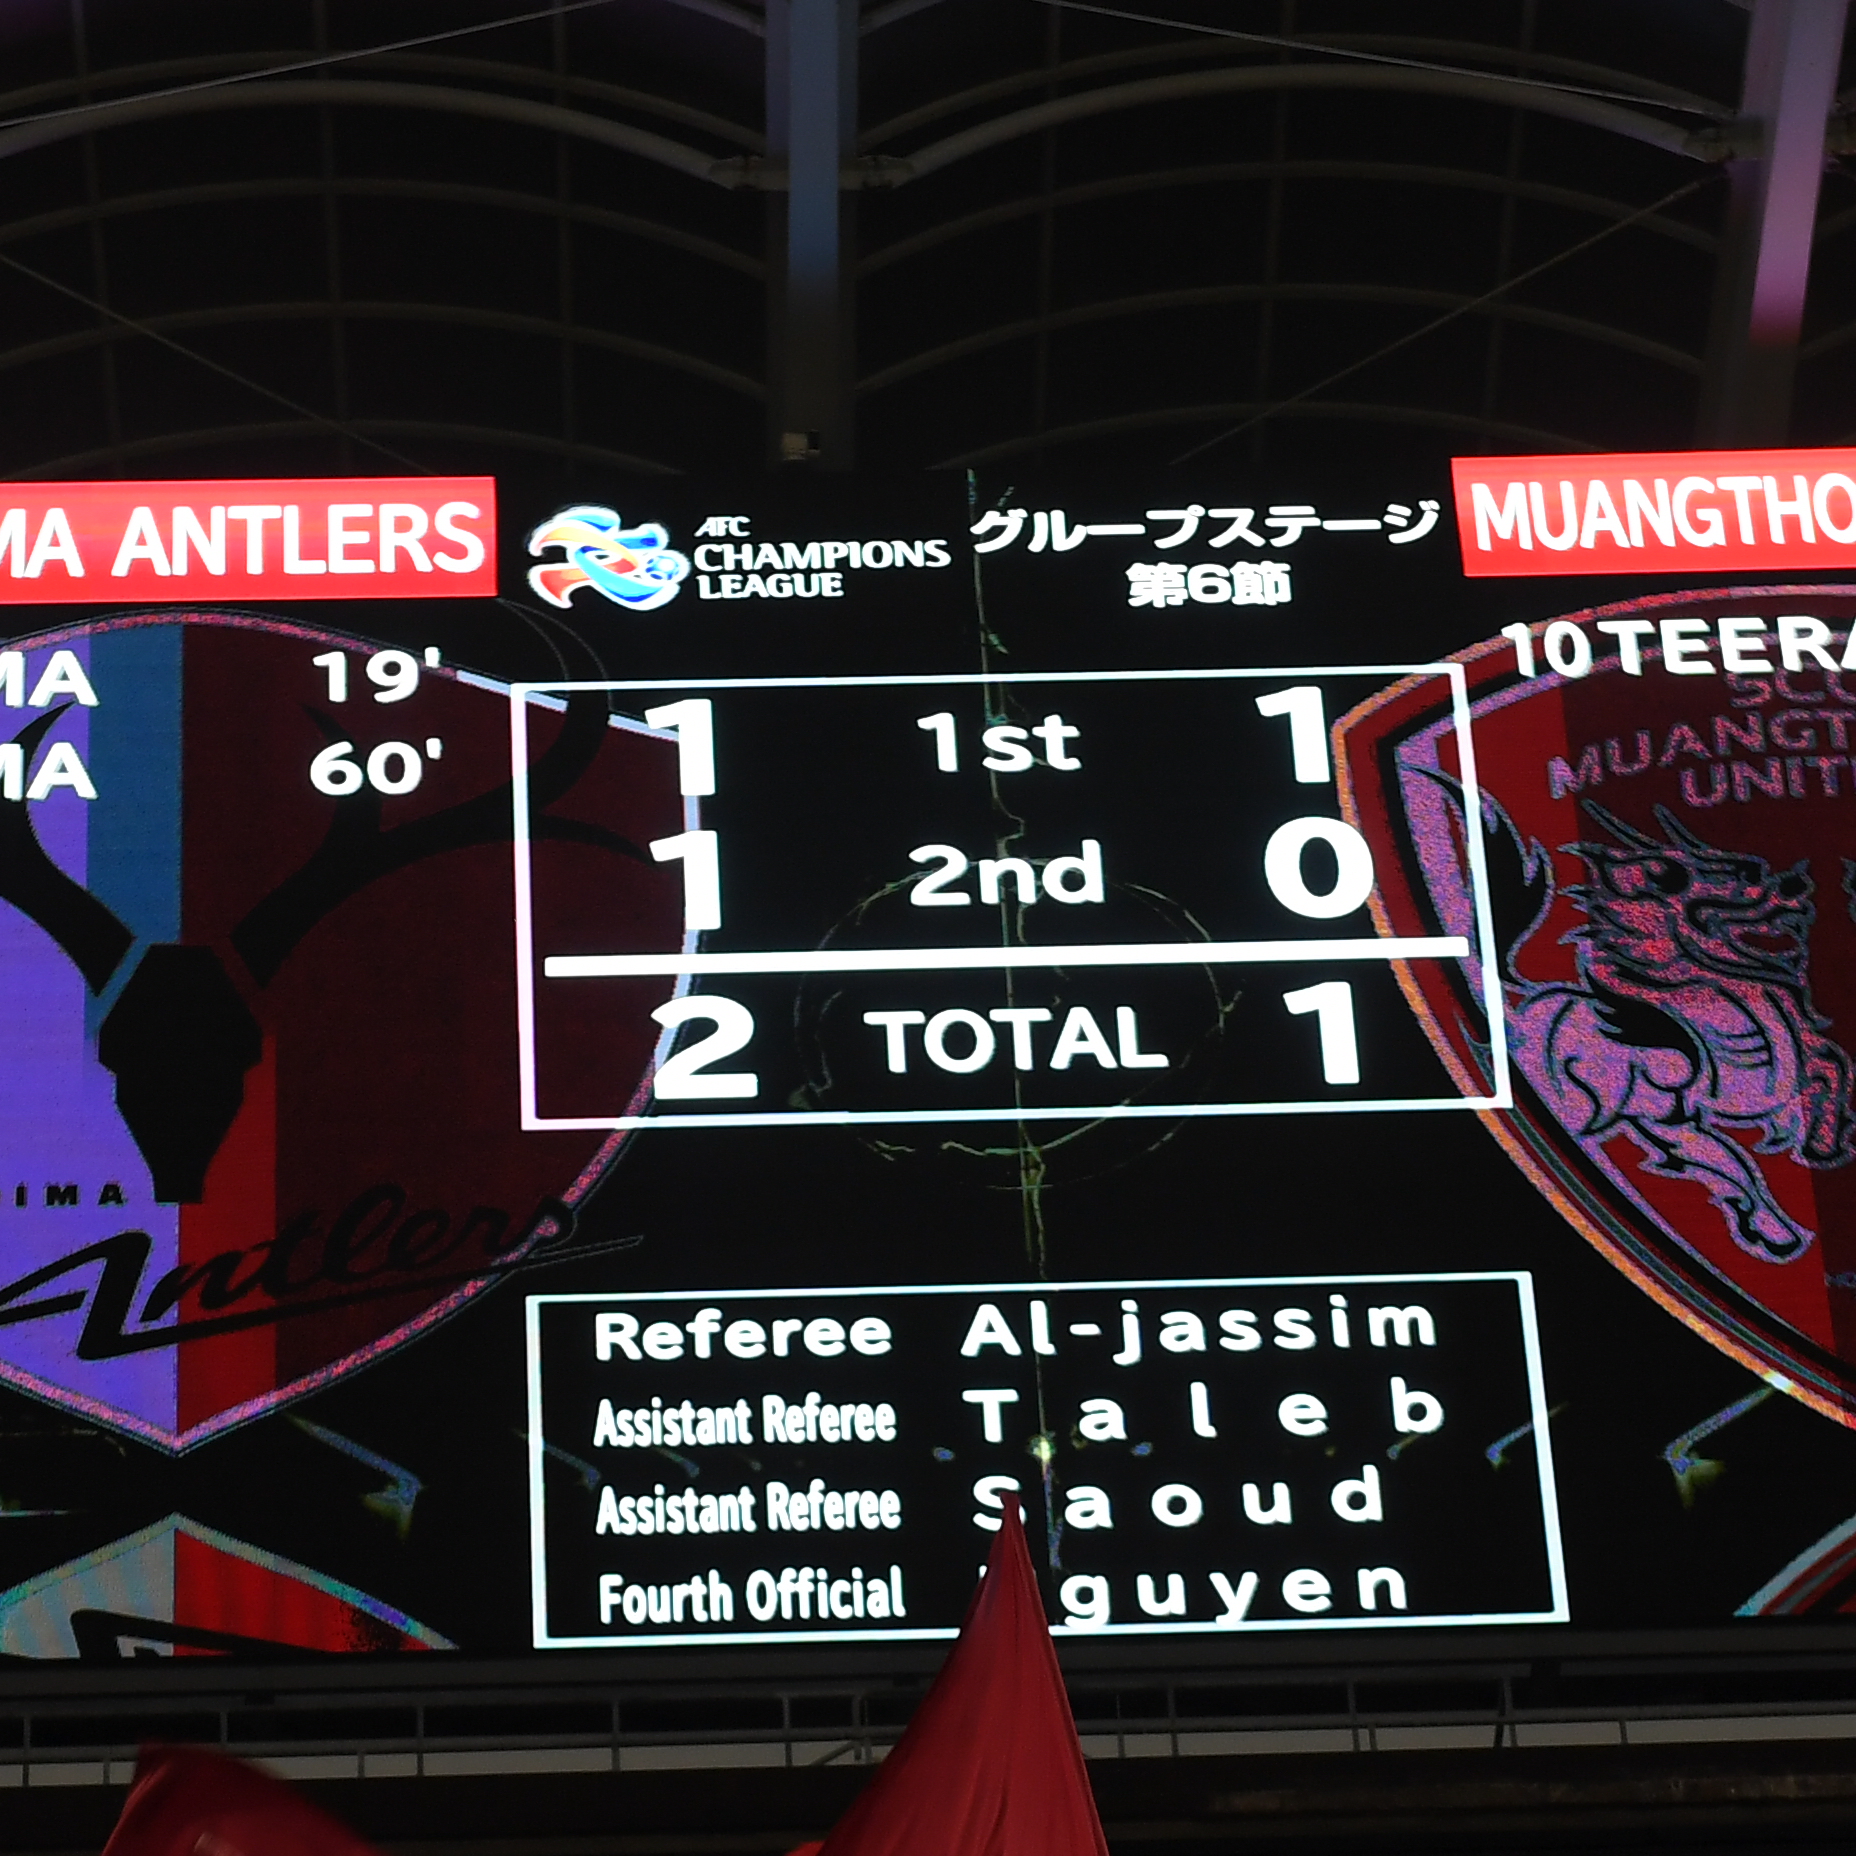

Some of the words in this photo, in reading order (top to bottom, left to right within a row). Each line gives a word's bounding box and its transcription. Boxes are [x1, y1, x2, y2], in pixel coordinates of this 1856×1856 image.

[110, 501, 486, 577] ANTLERS
[693, 516, 750, 538] AFC
[694, 539, 952, 572] CHAMPIONS
[969, 499, 1440, 553] グループステージ
[696, 572, 844, 599] LEAGUE
[1125, 560, 1292, 608] 第6節
[312, 646, 440, 703] 19'
[1502, 624, 1589, 681] 10
[310, 737, 441, 796] 60'
[645, 699, 716, 797] 1
[917, 712, 1081, 772] 1st
[1255, 686, 1330, 783] 1
[650, 829, 723, 930] 1
[908, 839, 1104, 906] 2nd
[1263, 816, 1375, 919] 0
[652, 994, 758, 1100] 2
[863, 1006, 1169, 1073] TOTAL
[1282, 981, 1360, 1084] 1
[595, 1308, 891, 1361] Referee
[960, 1294, 1435, 1365] Al-jassim
[593, 1396, 753, 1447] Assistant
[762, 1391, 896, 1444] Referee
[962, 1376, 1443, 1443] Taleb
[595, 1484, 756, 1535] Assistant
[766, 1478, 901, 1531] Referee
[973, 1466, 1383, 1531] Saoud
[599, 1569, 734, 1624] Fourth
[746, 1565, 906, 1621] Official
[978, 1565, 1409, 1626] guyen
